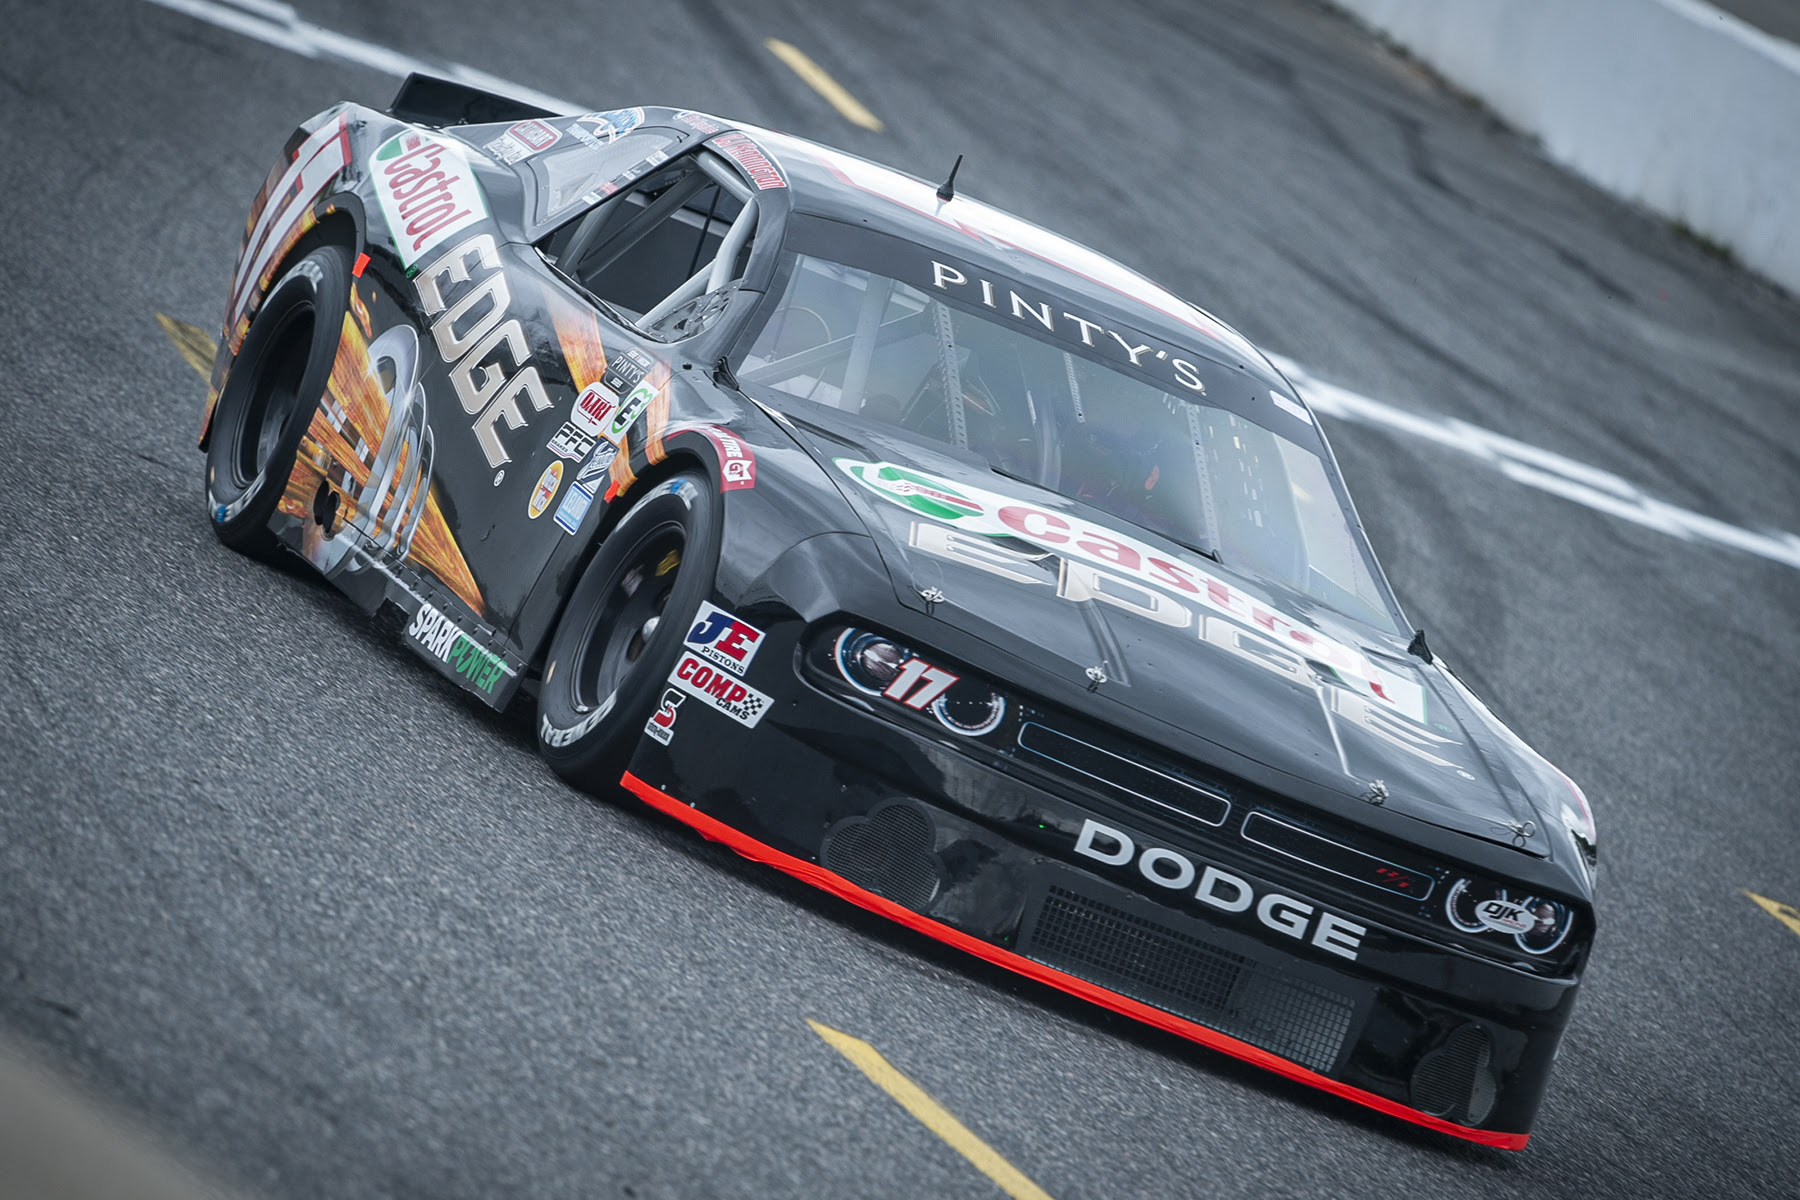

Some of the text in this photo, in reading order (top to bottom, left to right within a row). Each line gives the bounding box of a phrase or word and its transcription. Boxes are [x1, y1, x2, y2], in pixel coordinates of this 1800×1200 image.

[384, 143, 472, 251] Castrol
[413, 233, 554, 469] EDGE
[931, 260, 1207, 393] PINTY'S
[611, 355, 645, 384] PINTY'S
[554, 423, 596, 458] PFC
[998, 505, 1396, 704] Castrol
[686, 611, 760, 662] JE
[701, 645, 744, 674] PISTONS
[677, 658, 747, 703] COMP
[882, 657, 961, 711] 17
[715, 697, 750, 720] CAMS
[1073, 818, 1367, 961] DODGE
[1482, 902, 1525, 919] DJK
